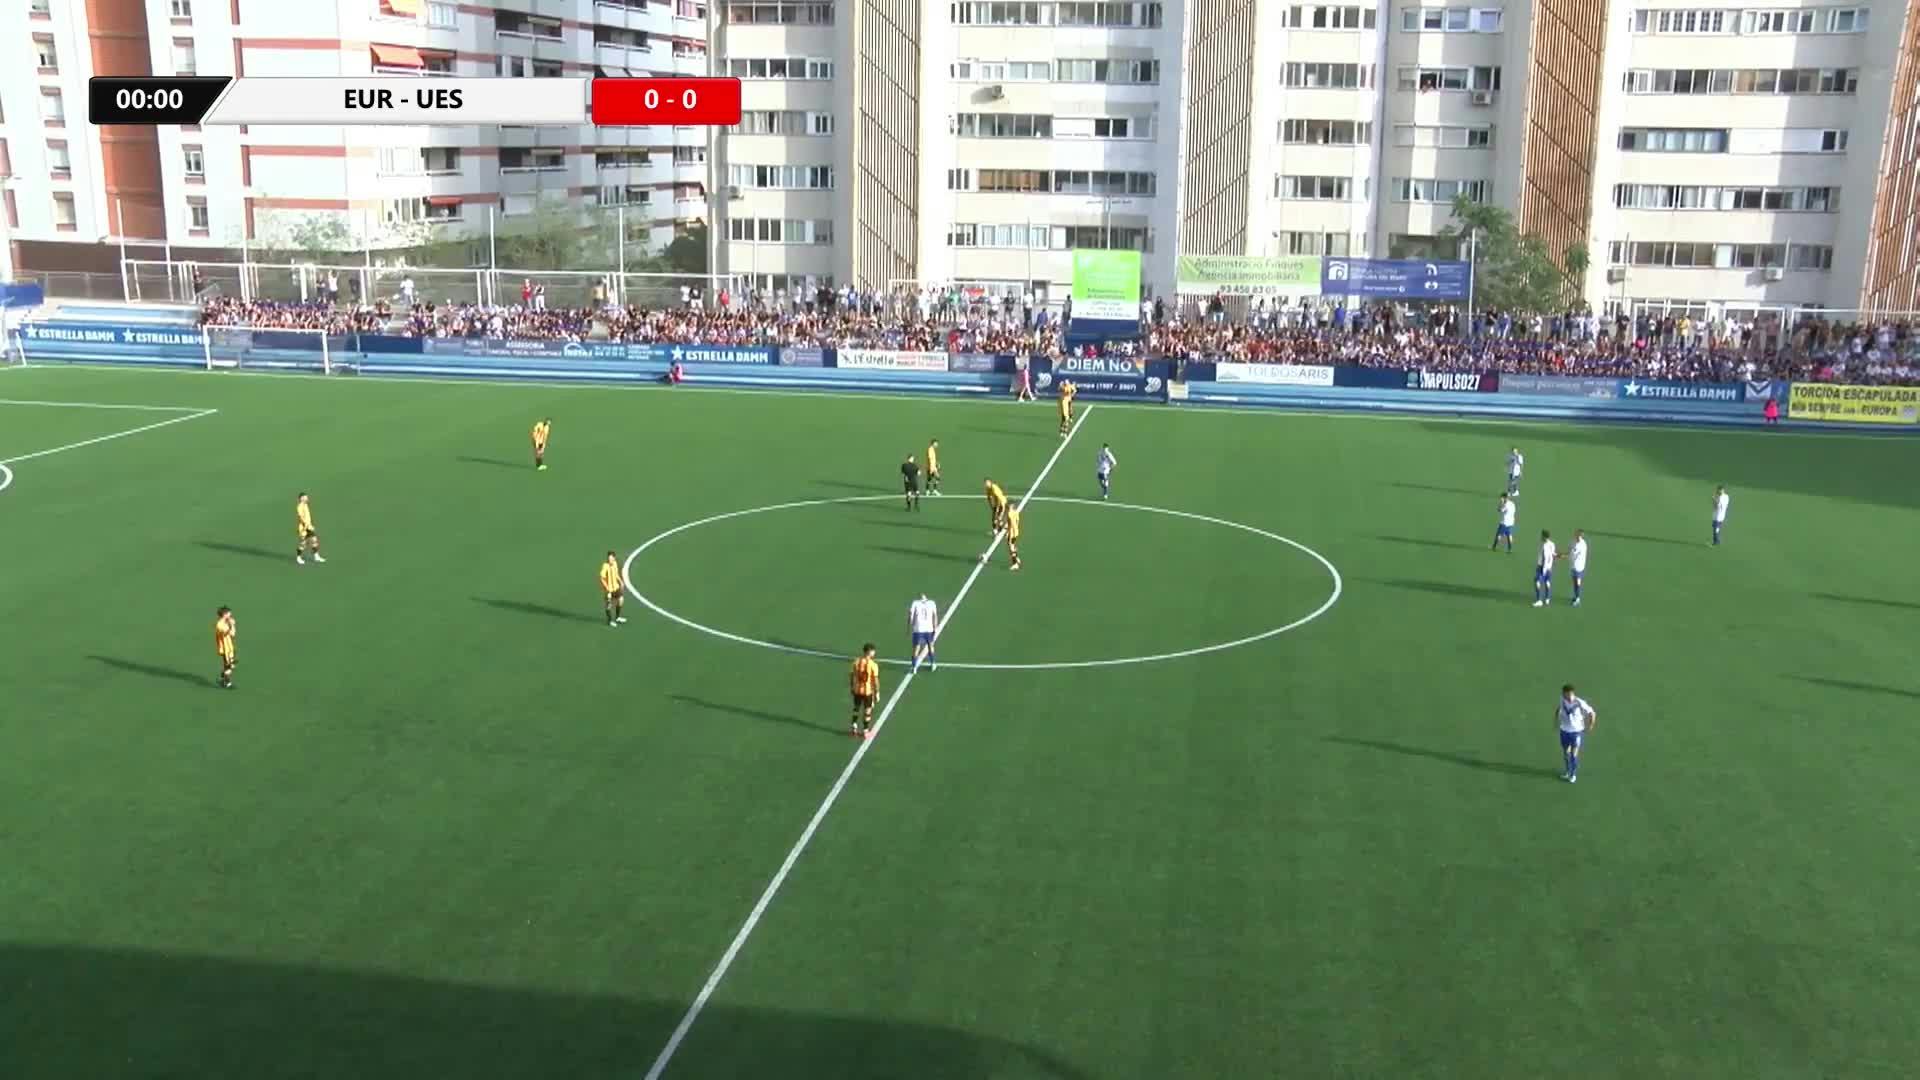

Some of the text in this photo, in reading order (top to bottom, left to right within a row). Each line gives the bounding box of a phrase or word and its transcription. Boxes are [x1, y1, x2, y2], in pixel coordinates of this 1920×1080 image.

[38, 327, 116, 343] ESTRELLA DAMM
[135, 330, 181, 344] ESTRELLA
[685, 348, 769, 363] ESTRELLA DAMM
[1066, 357, 1132, 372] DIEM NO
[1640, 384, 1737, 400] ESTRELLA DAMM
[1793, 386, 1917, 402] TORCIDA ESCAPULADA
